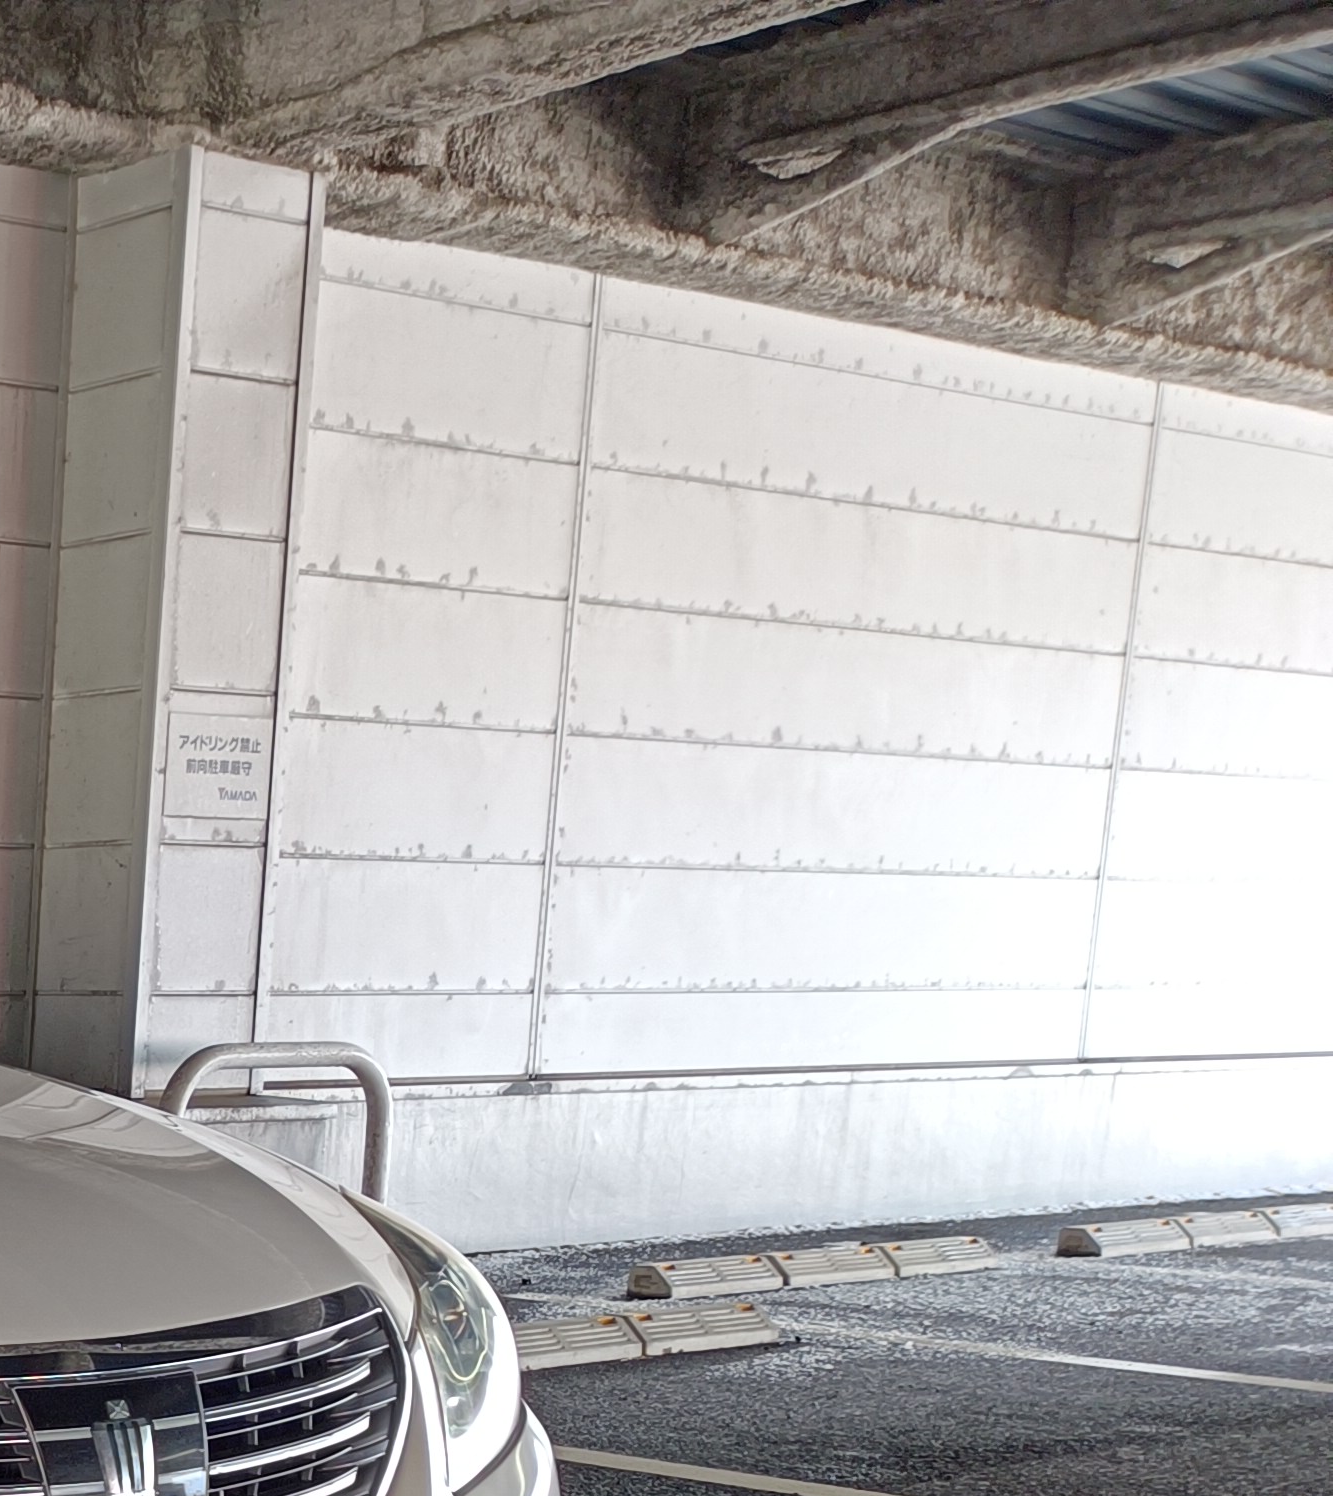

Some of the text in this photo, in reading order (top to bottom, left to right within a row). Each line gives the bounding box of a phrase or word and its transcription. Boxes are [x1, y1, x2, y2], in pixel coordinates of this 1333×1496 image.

[179, 734, 261, 754] アイドリング禁止
[218, 787, 257, 801] YAMADA
